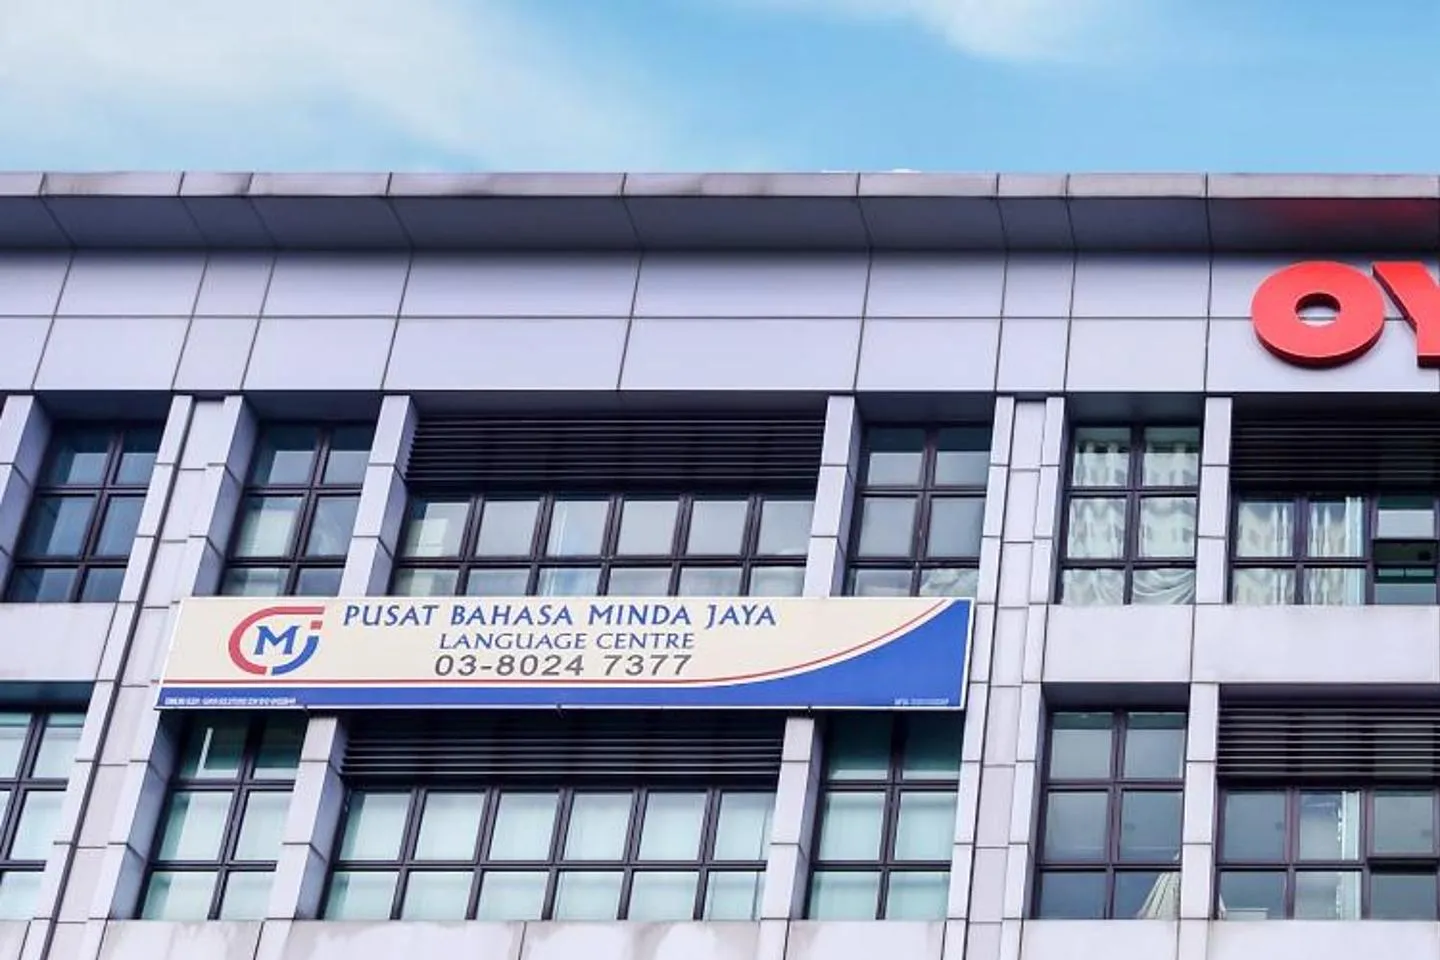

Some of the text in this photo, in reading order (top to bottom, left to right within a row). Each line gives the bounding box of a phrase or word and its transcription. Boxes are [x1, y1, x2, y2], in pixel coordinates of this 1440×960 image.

[343, 603, 777, 630] PUSAT BAHASA MINDA JAYA
[438, 632, 695, 651] LANGUAGE CENTRE
[434, 653, 692, 677] 03-8024 7377
